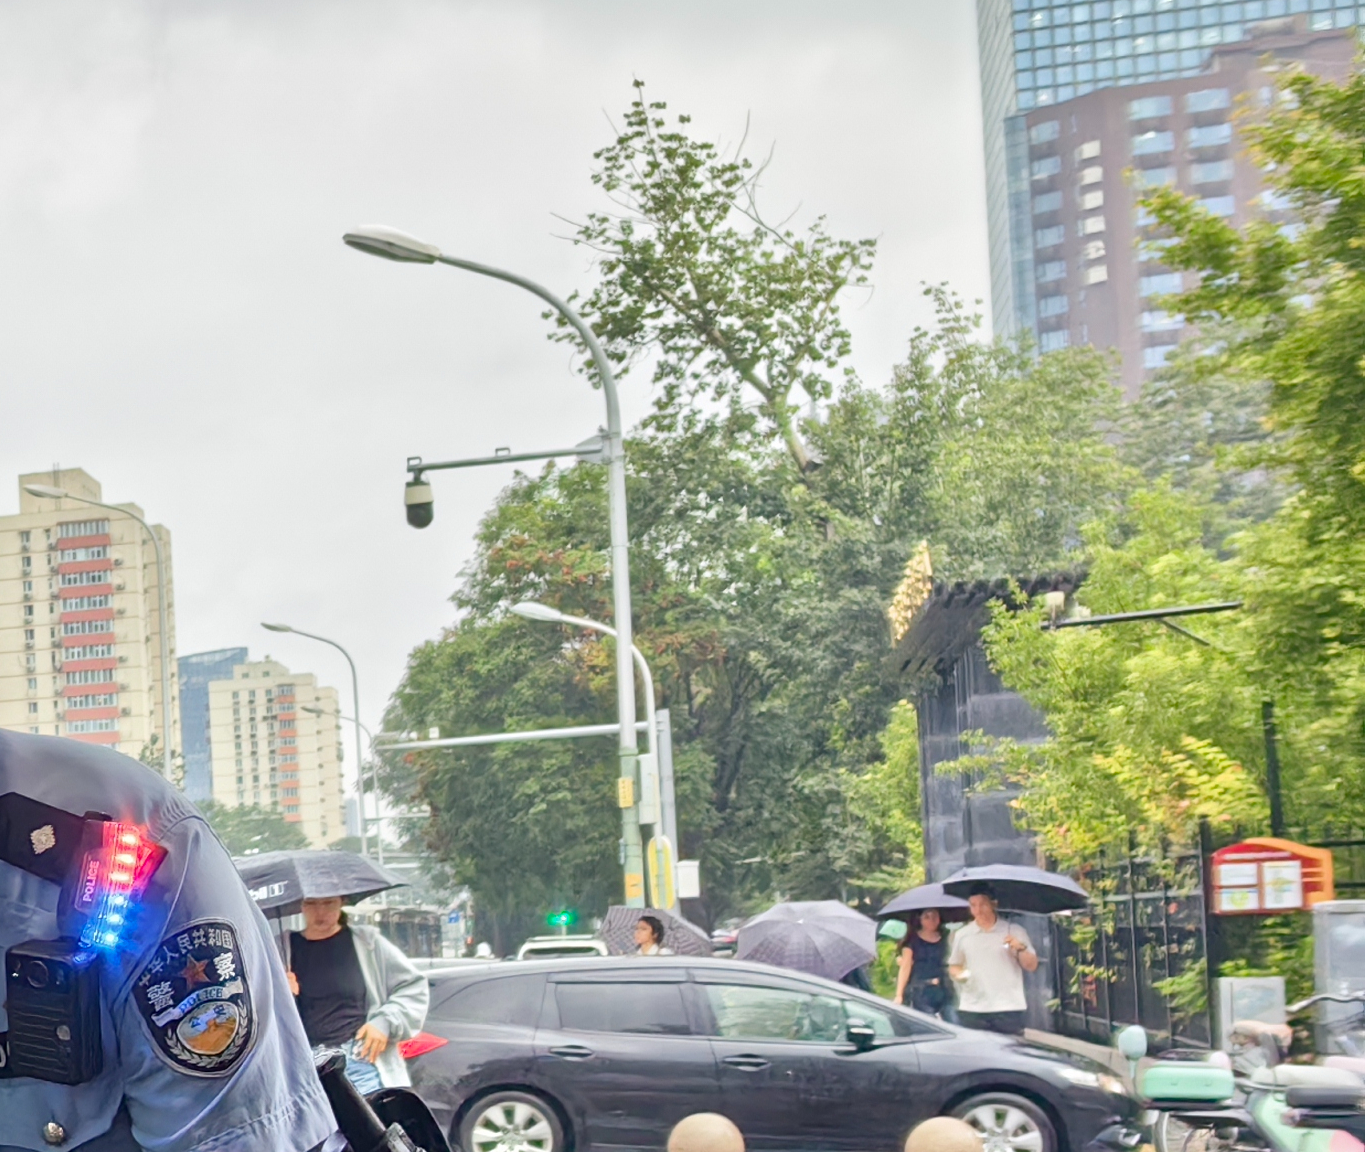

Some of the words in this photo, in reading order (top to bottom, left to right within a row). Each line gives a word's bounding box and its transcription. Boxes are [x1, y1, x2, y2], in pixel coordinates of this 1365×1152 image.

[82, 860, 100, 902] POLICE
[139, 928, 233, 987] 中华人民共和国
[178, 987, 224, 1014] POLICE
